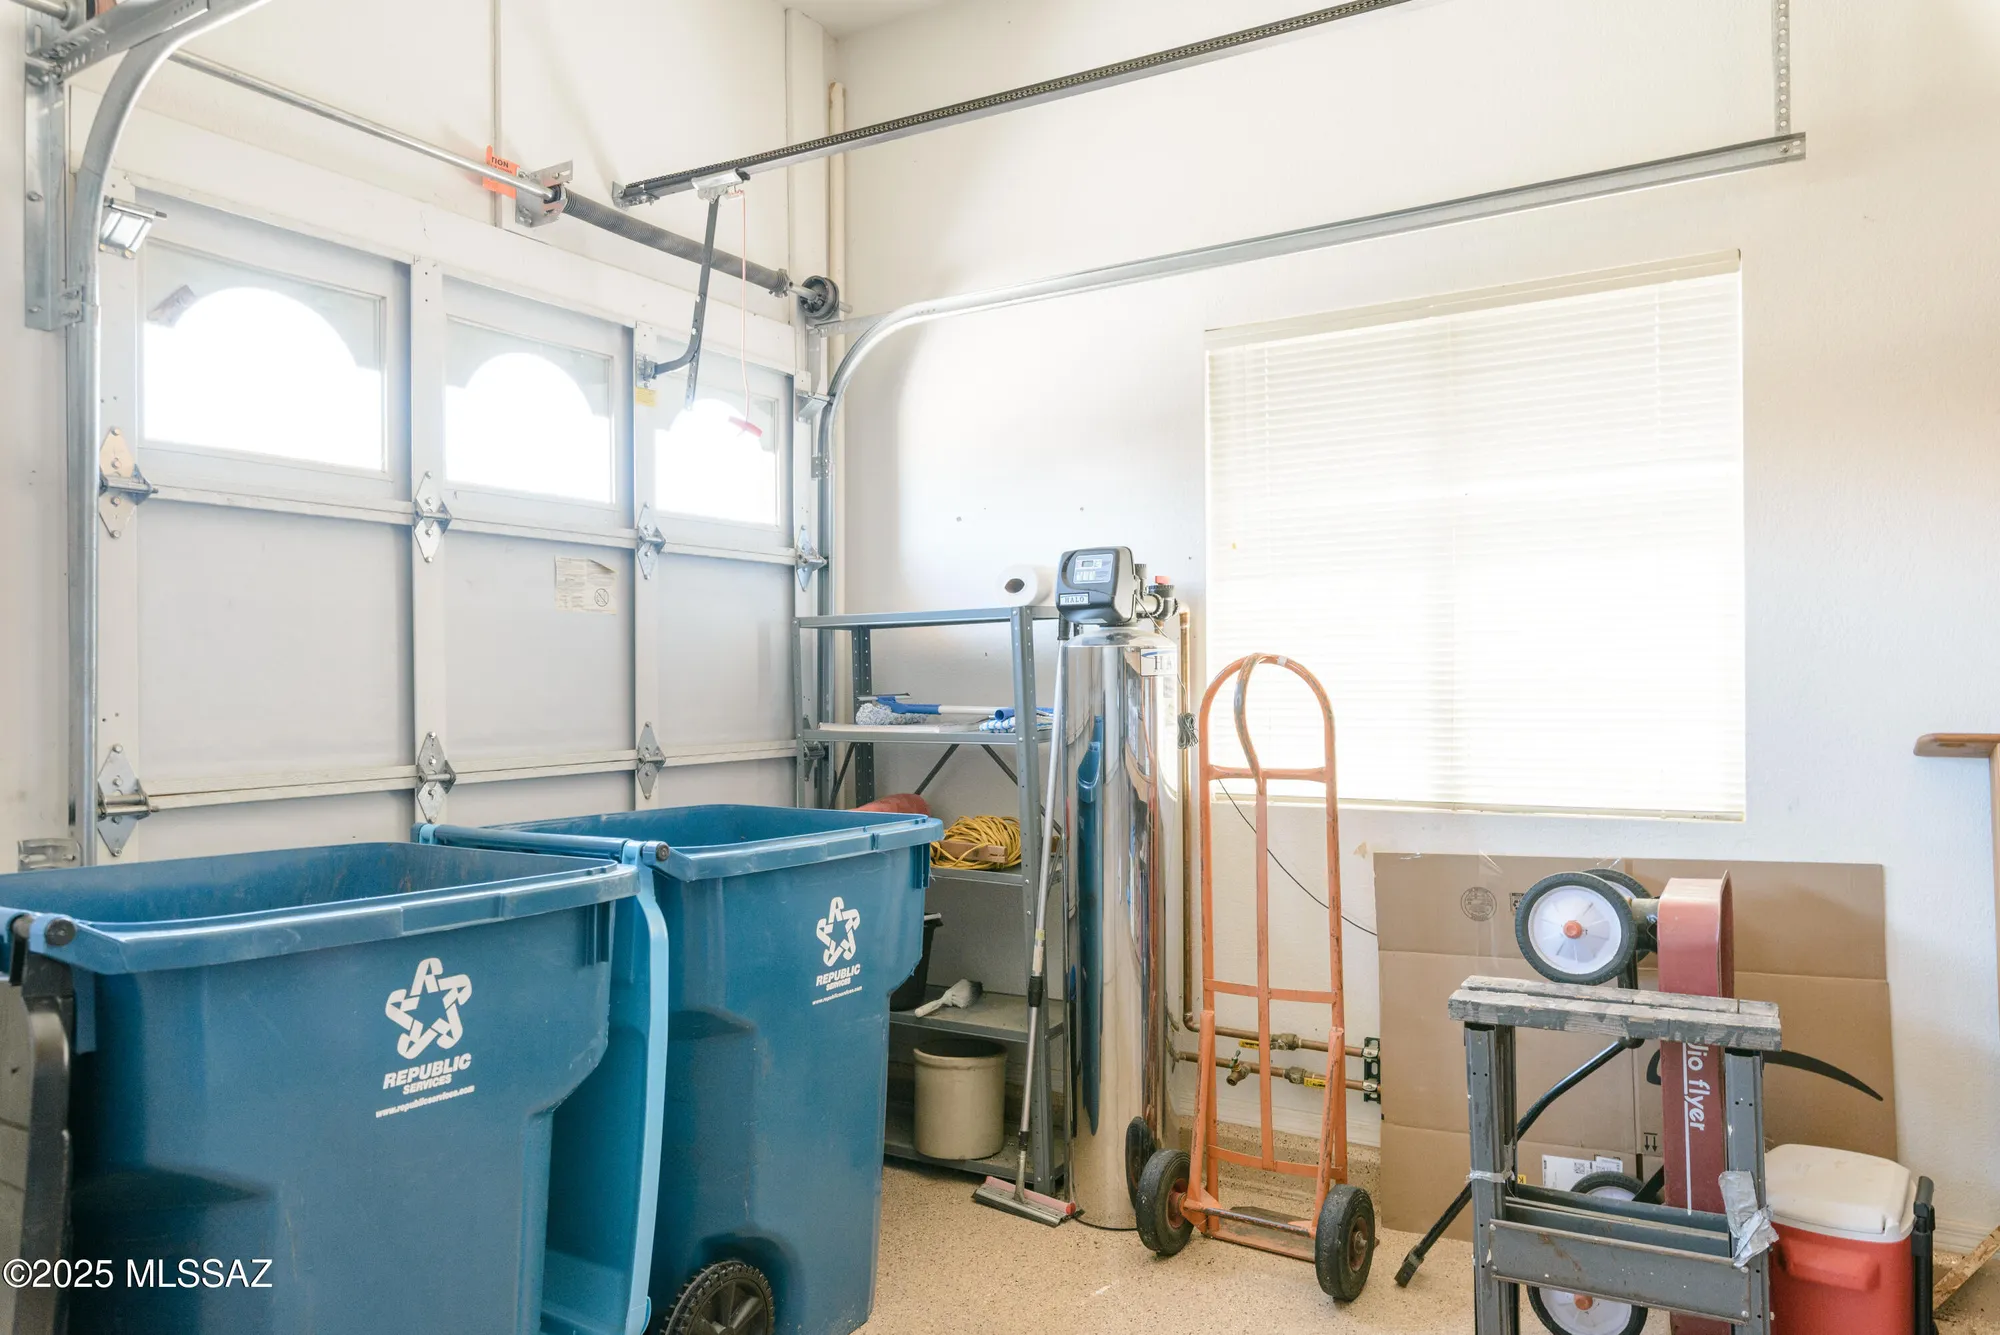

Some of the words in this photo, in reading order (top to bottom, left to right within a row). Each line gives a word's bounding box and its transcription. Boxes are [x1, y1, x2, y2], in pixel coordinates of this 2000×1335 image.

[815, 963, 861, 987] REPUBLIC
[383, 1053, 472, 1090] REPUBLIC
[402, 1073, 453, 1095] SERVICES
[1684, 1079, 1711, 1131] flyer
